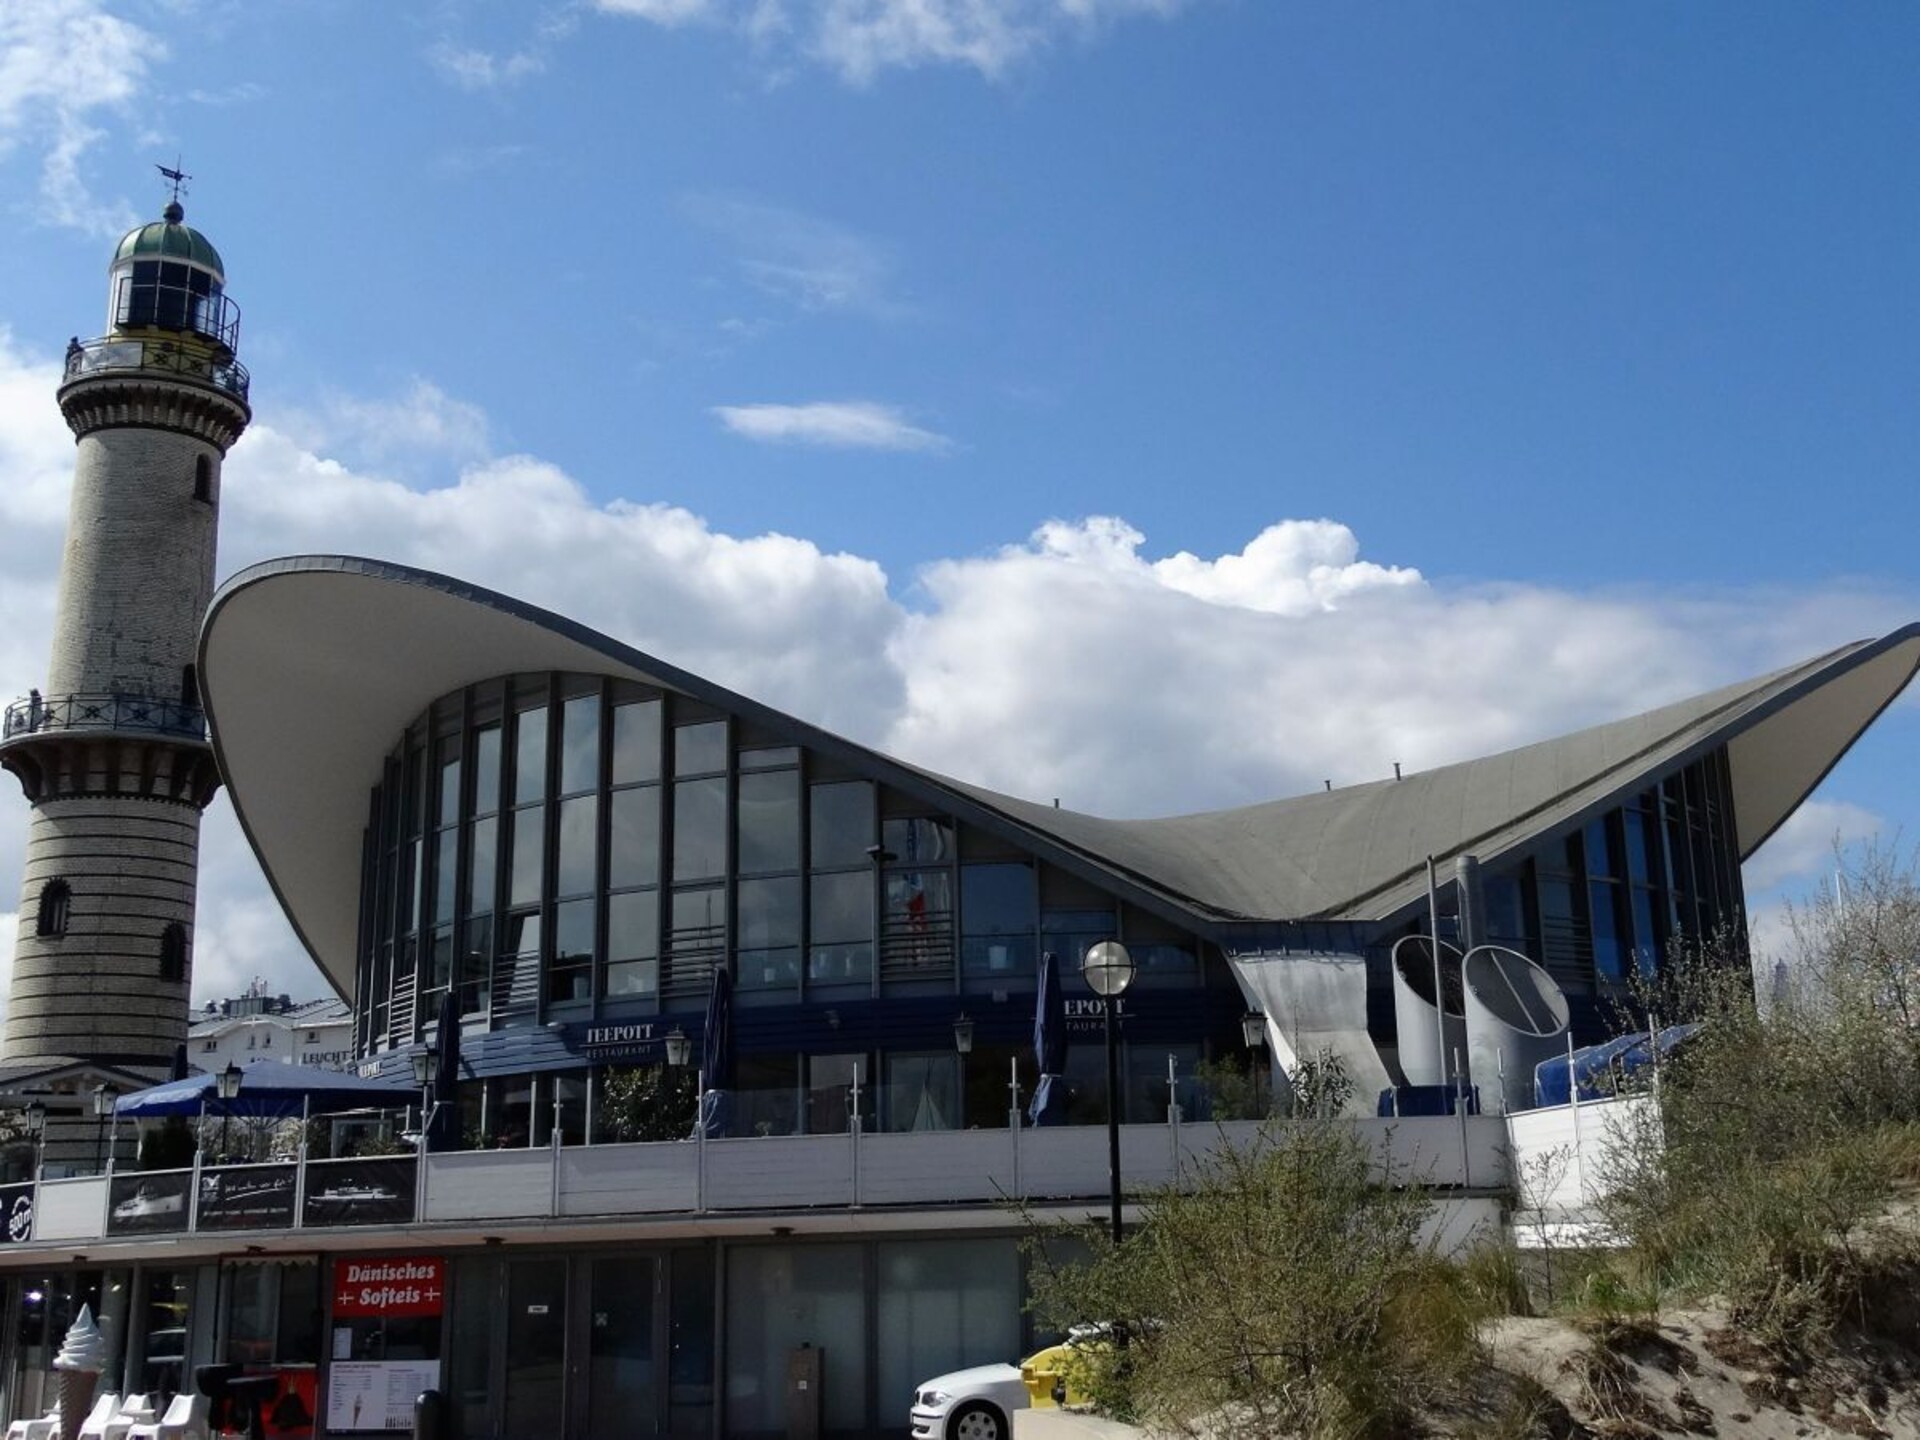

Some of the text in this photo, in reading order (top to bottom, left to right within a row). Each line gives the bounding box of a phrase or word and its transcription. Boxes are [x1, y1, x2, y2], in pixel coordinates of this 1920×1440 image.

[1064, 998, 1126, 1016] EPOT
[587, 1023, 654, 1043] TEEPOTT
[347, 1262, 436, 1283] Dänisches
[360, 1286, 421, 1308] Softeis
